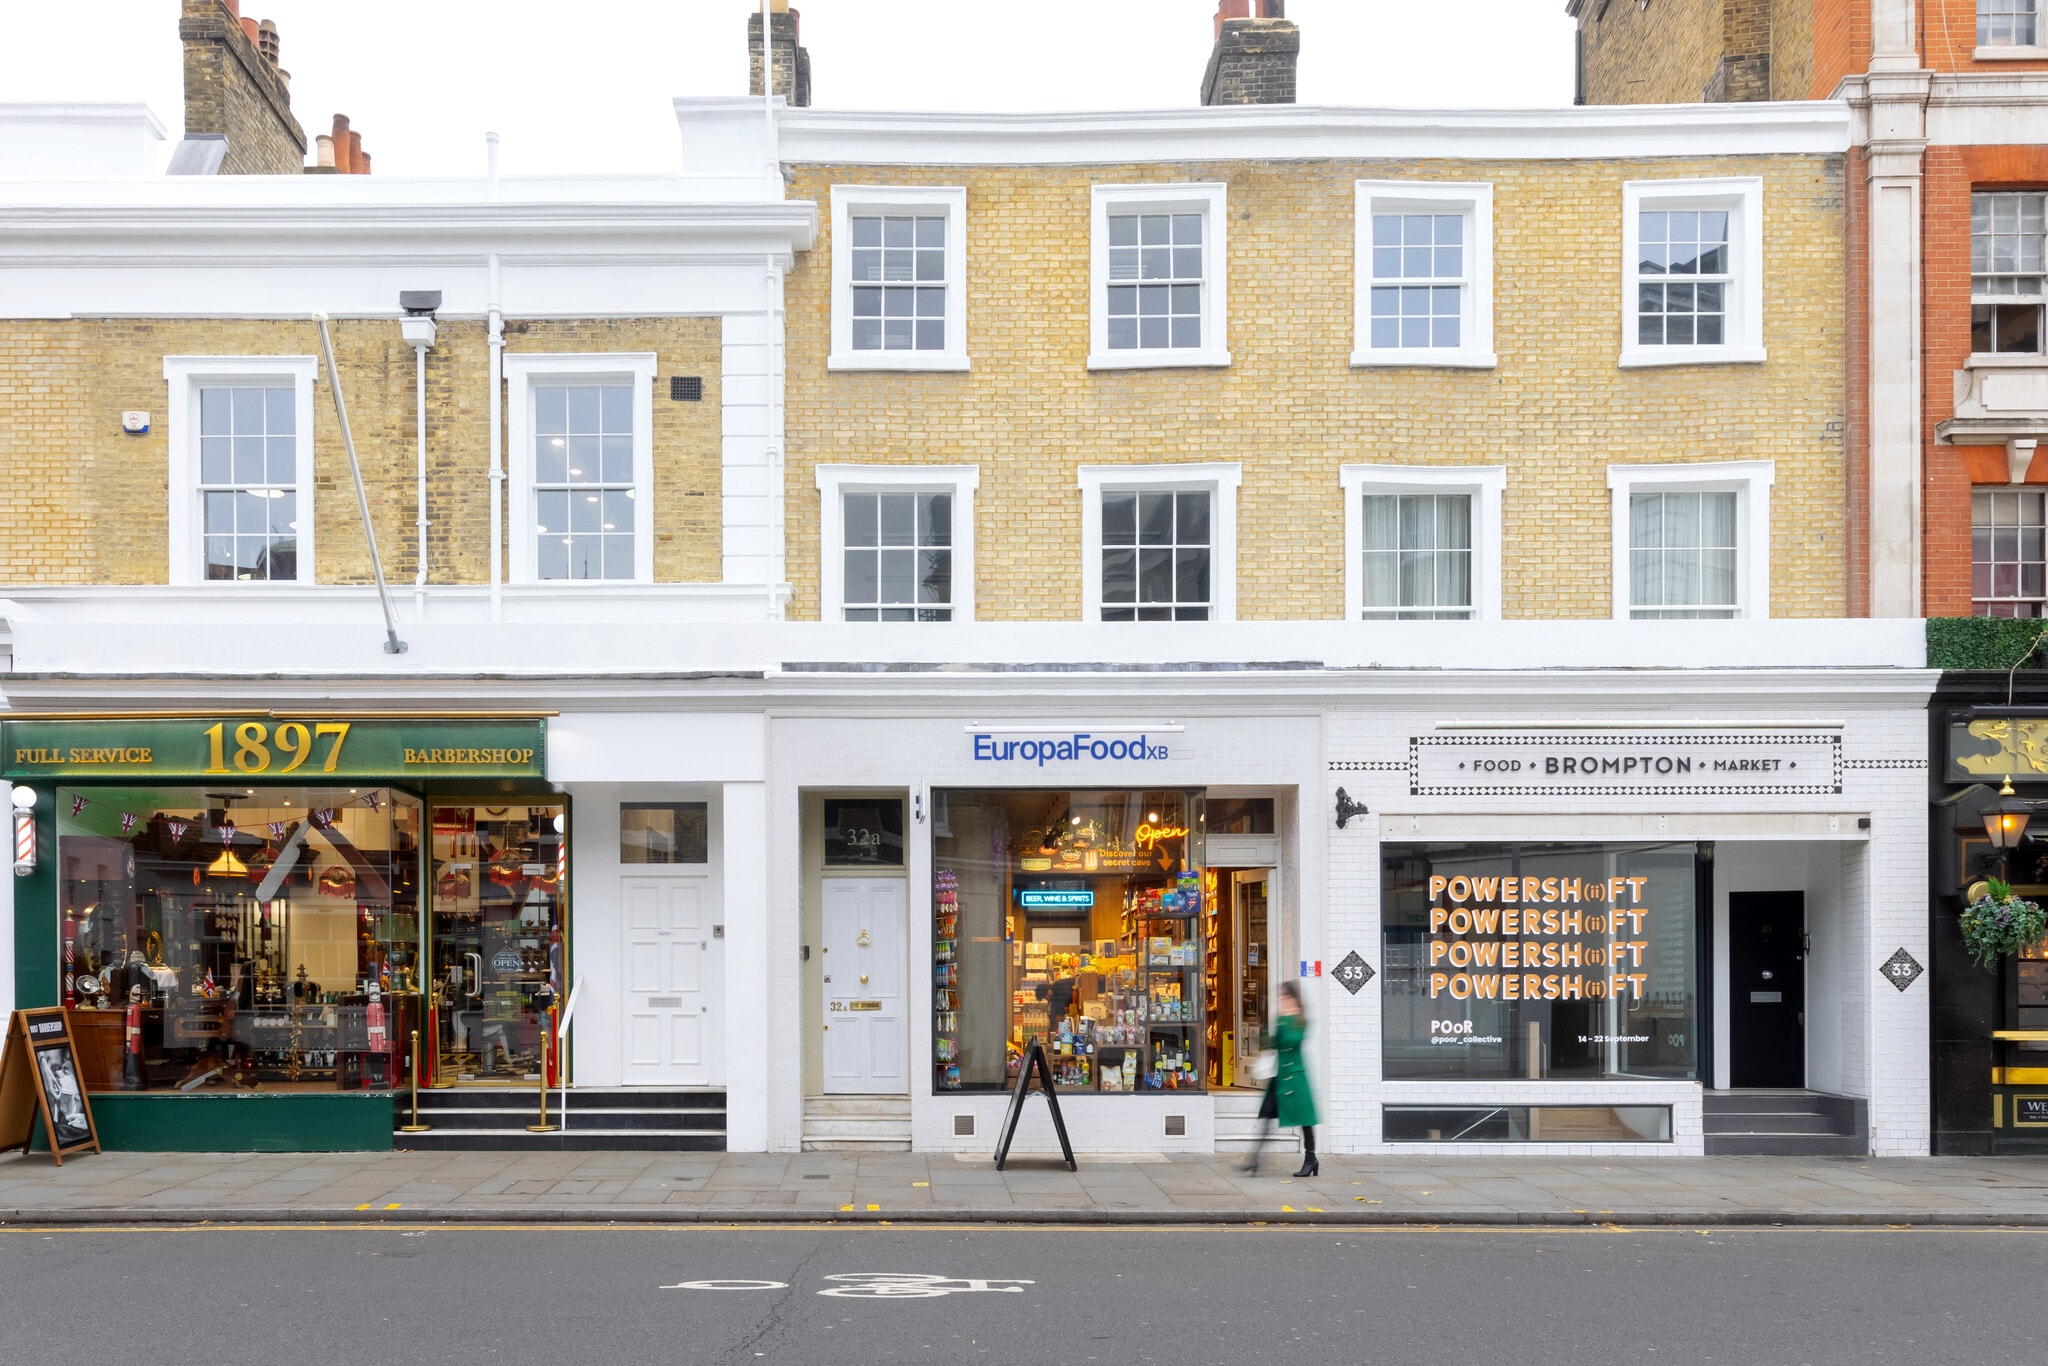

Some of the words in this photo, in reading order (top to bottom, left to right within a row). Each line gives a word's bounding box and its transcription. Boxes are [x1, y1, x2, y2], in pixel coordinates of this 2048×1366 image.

[203, 722, 351, 773] 1897
[15, 749, 65, 763] FULL
[69, 748, 152, 763] SERVICE
[404, 749, 534, 764] BARBERSHOP
[1473, 760, 1522, 772] FOOD
[1545, 756, 1692, 774] BROMPTON
[1713, 759, 1782, 771] MARKET
[847, 829, 881, 846] 32a
[1136, 824, 1189, 849] Open
[1100, 850, 1136, 858] Discover
[1429, 875, 1648, 903] POWERSH(ii)FT
[1430, 907, 1648, 935] POWERSH(ii)FT
[1430, 940, 1648, 968] POWERSH(ii)FT
[493, 959, 520, 967] OPEN
[1892, 963, 1911, 976] 33
[1344, 966, 1363, 980] 33
[1430, 972, 1648, 1000] POWERSH(ii)FT
[1430, 1020, 1473, 1034] POoR
[1431, 1036, 1502, 1045] @poor_collective
[1605, 1035, 1650, 1044] September
